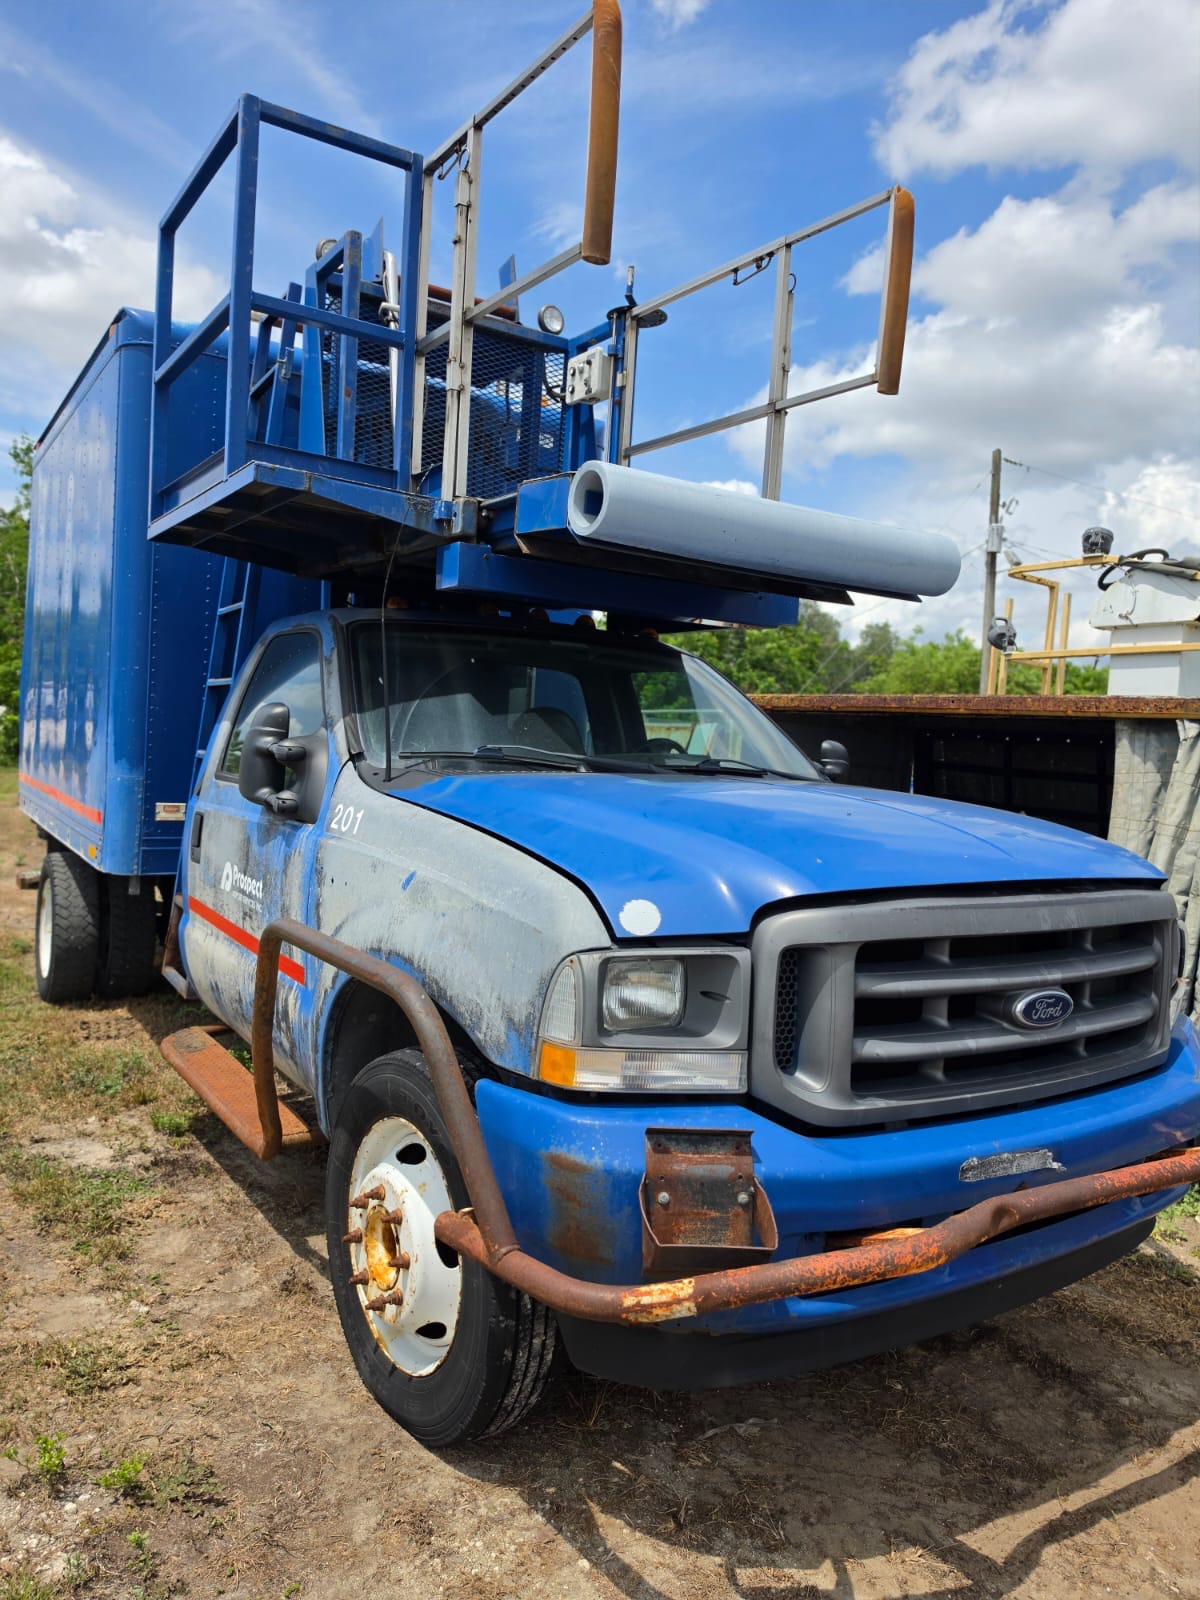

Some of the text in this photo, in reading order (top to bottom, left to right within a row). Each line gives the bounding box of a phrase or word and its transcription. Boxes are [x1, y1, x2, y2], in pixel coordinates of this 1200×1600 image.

[330, 803, 365, 835] 201
[232, 864, 263, 900] Prospect
[1032, 998, 1063, 1020] Ford
